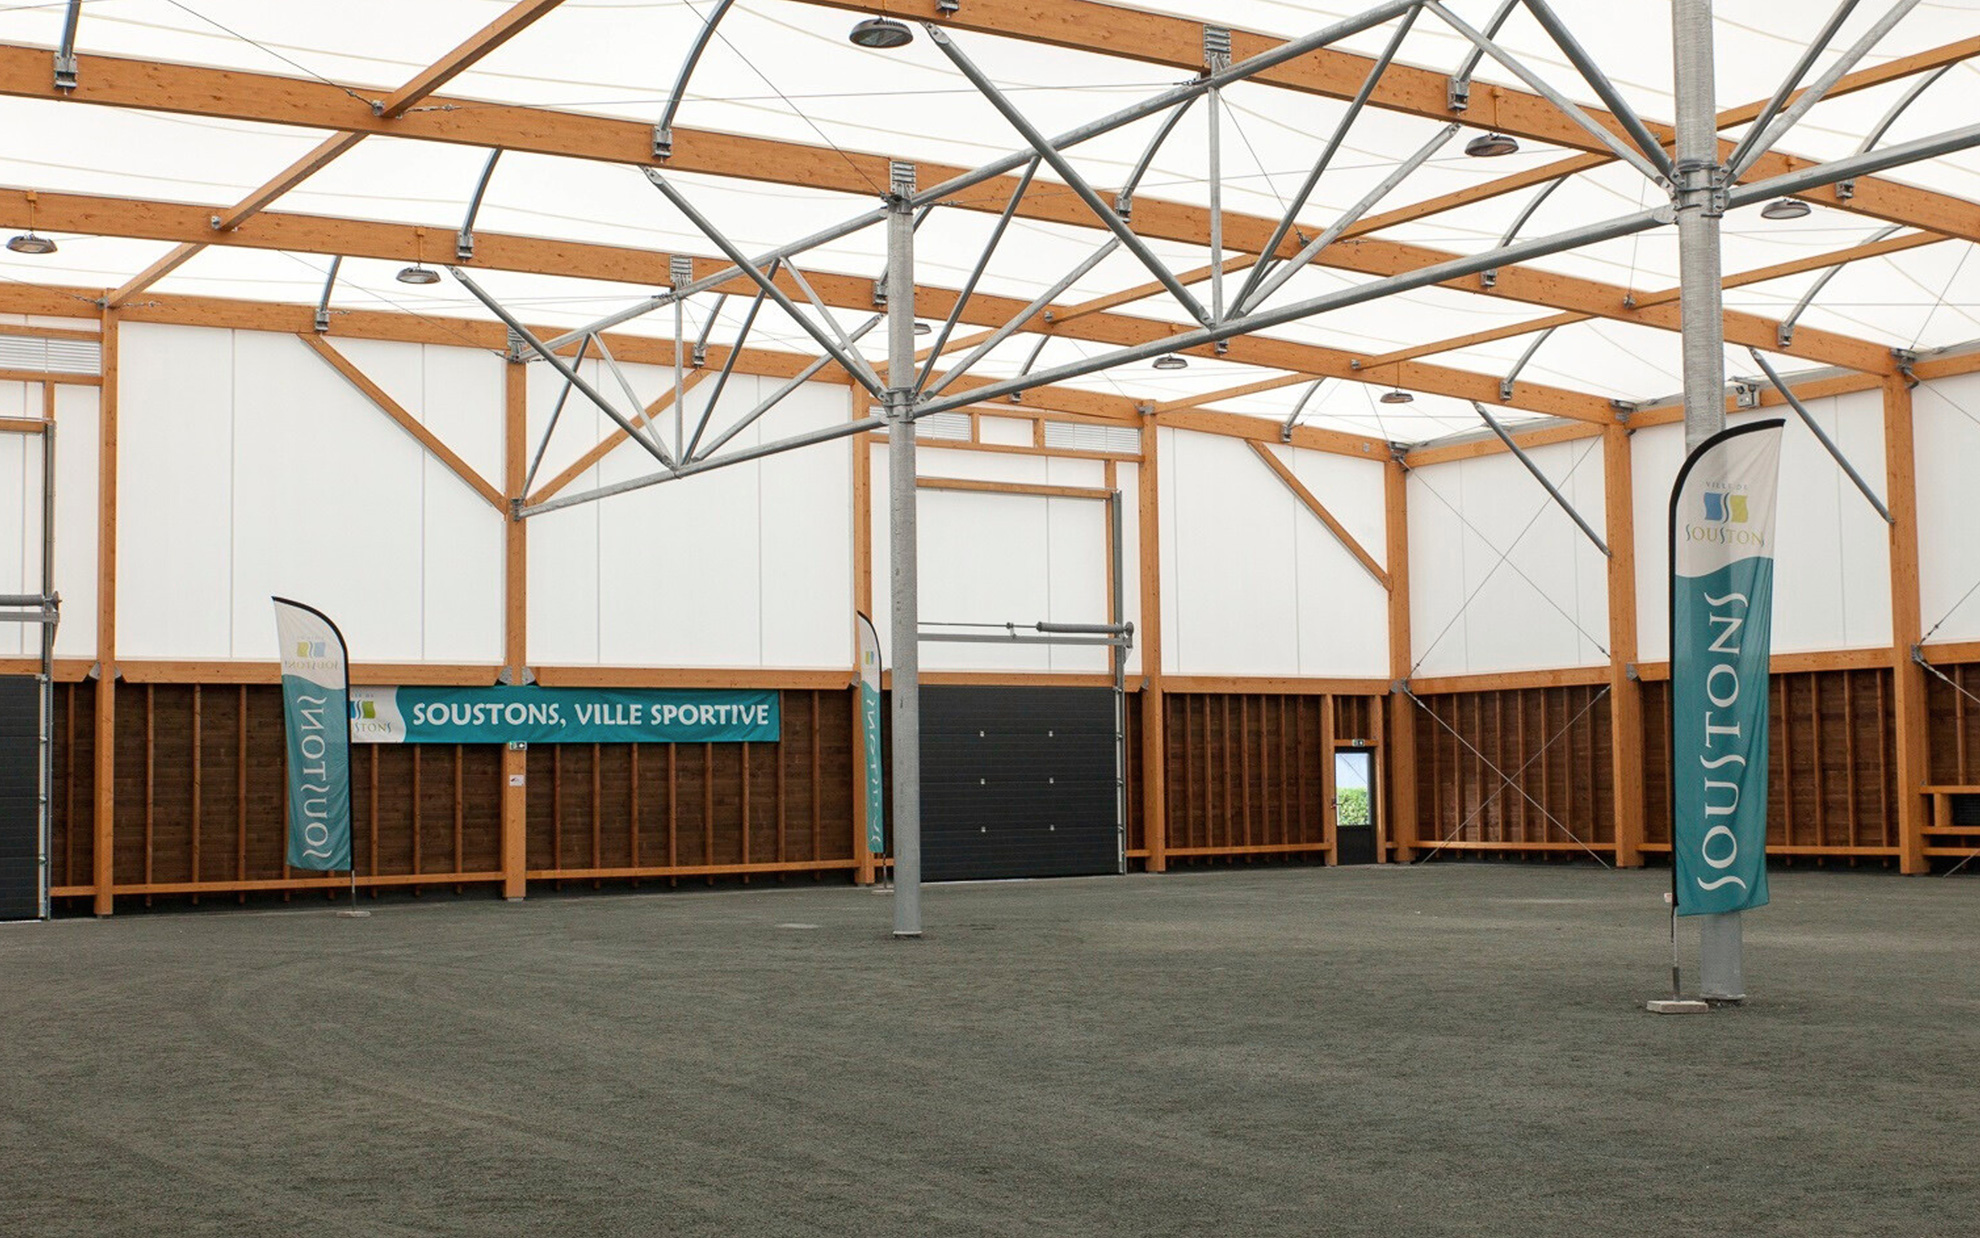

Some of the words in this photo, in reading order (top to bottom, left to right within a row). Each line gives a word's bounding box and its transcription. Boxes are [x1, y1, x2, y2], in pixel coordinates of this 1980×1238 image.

[354, 721, 392, 733] STONS
[412, 702, 567, 728] SOUSTONS,
[574, 703, 642, 726] VILLE
[650, 704, 769, 726] SPORTIVE
[1697, 591, 1749, 891] SOUSTONS
